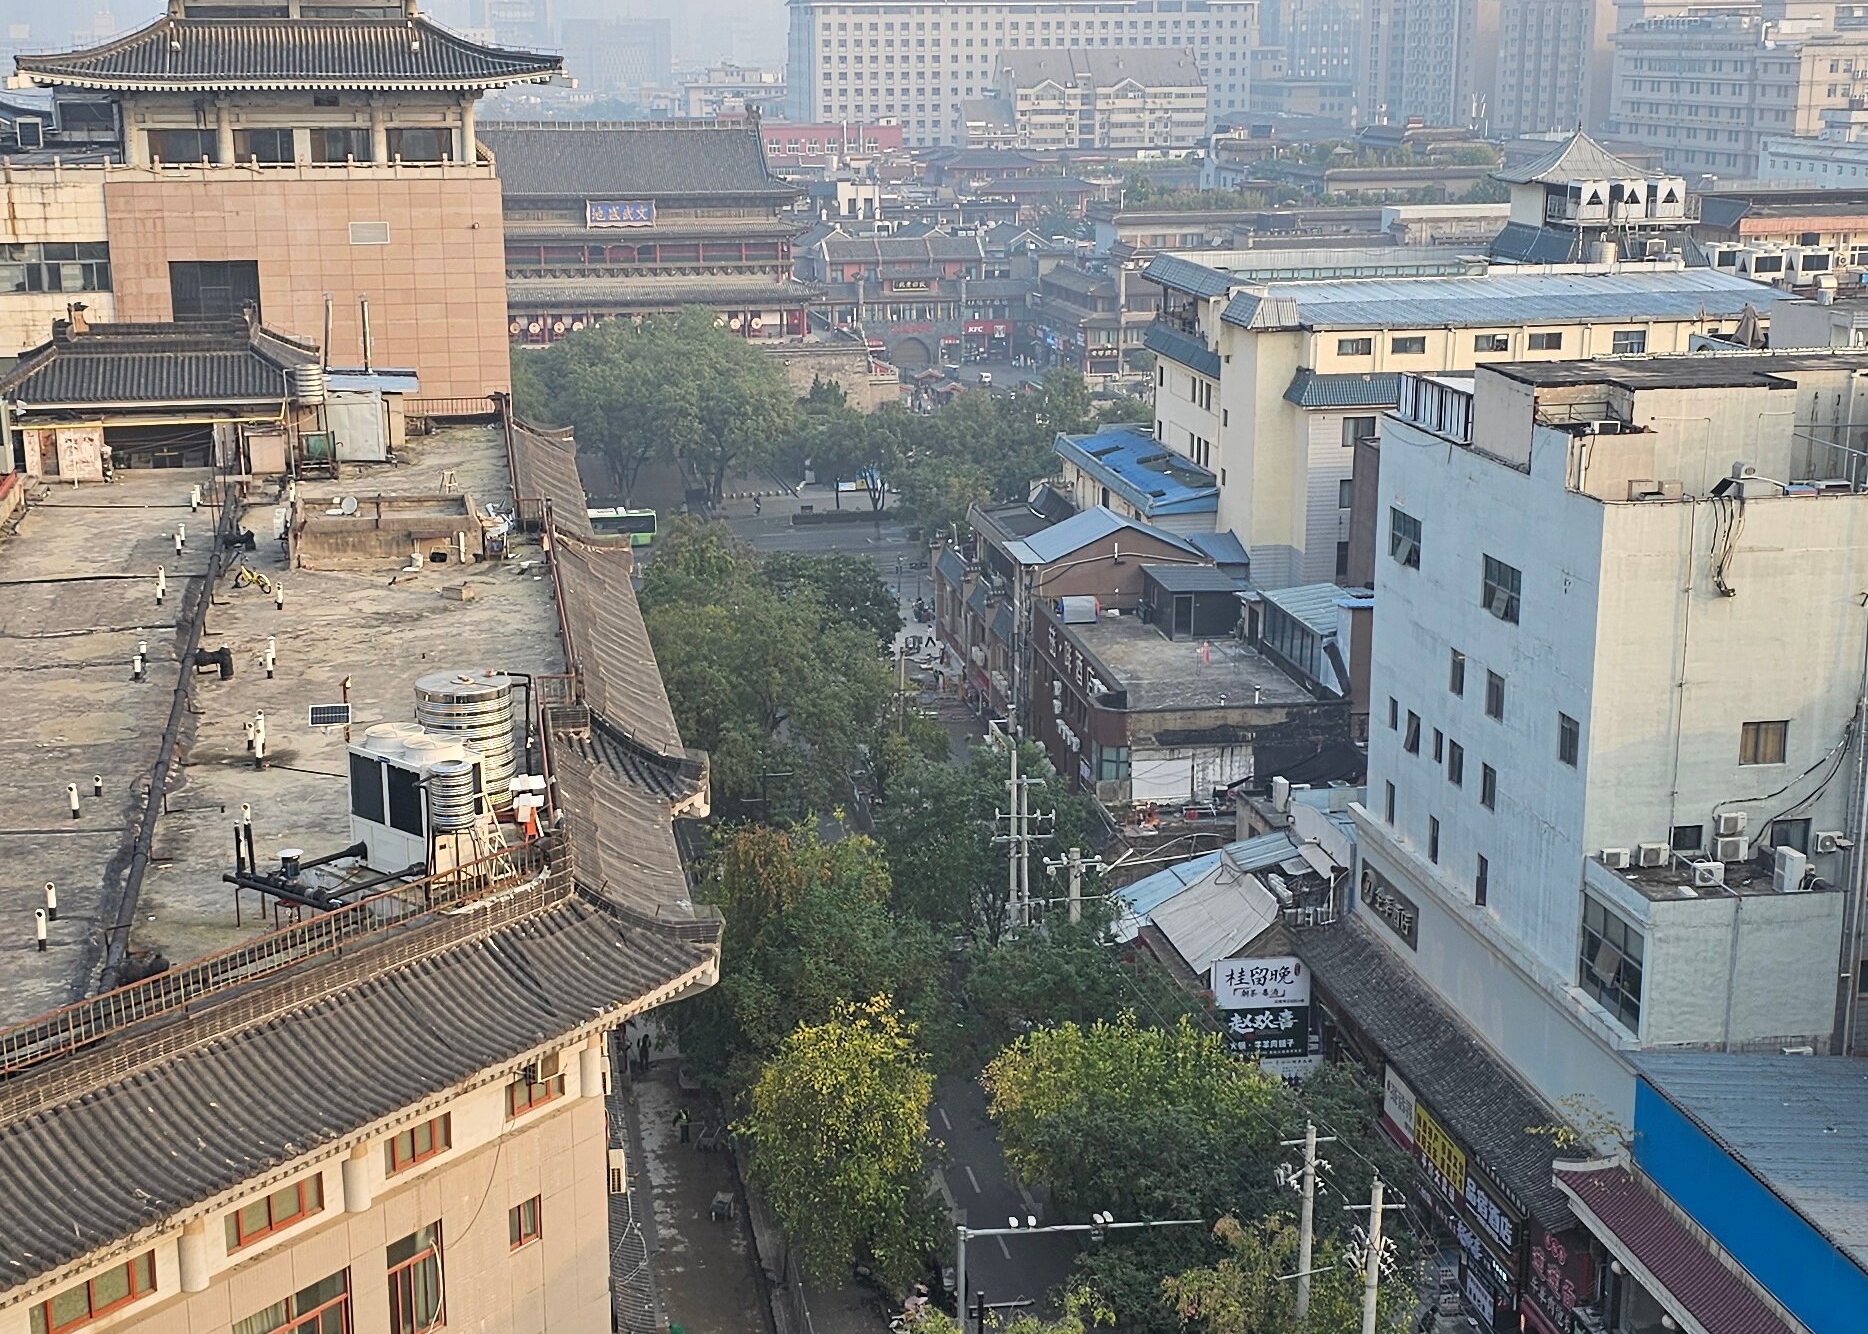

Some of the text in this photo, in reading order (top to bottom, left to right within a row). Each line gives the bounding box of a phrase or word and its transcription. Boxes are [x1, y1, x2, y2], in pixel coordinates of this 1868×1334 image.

[1225, 965, 1294, 987] 桂留晚
[1229, 1008, 1299, 1034] 赵欢喜
